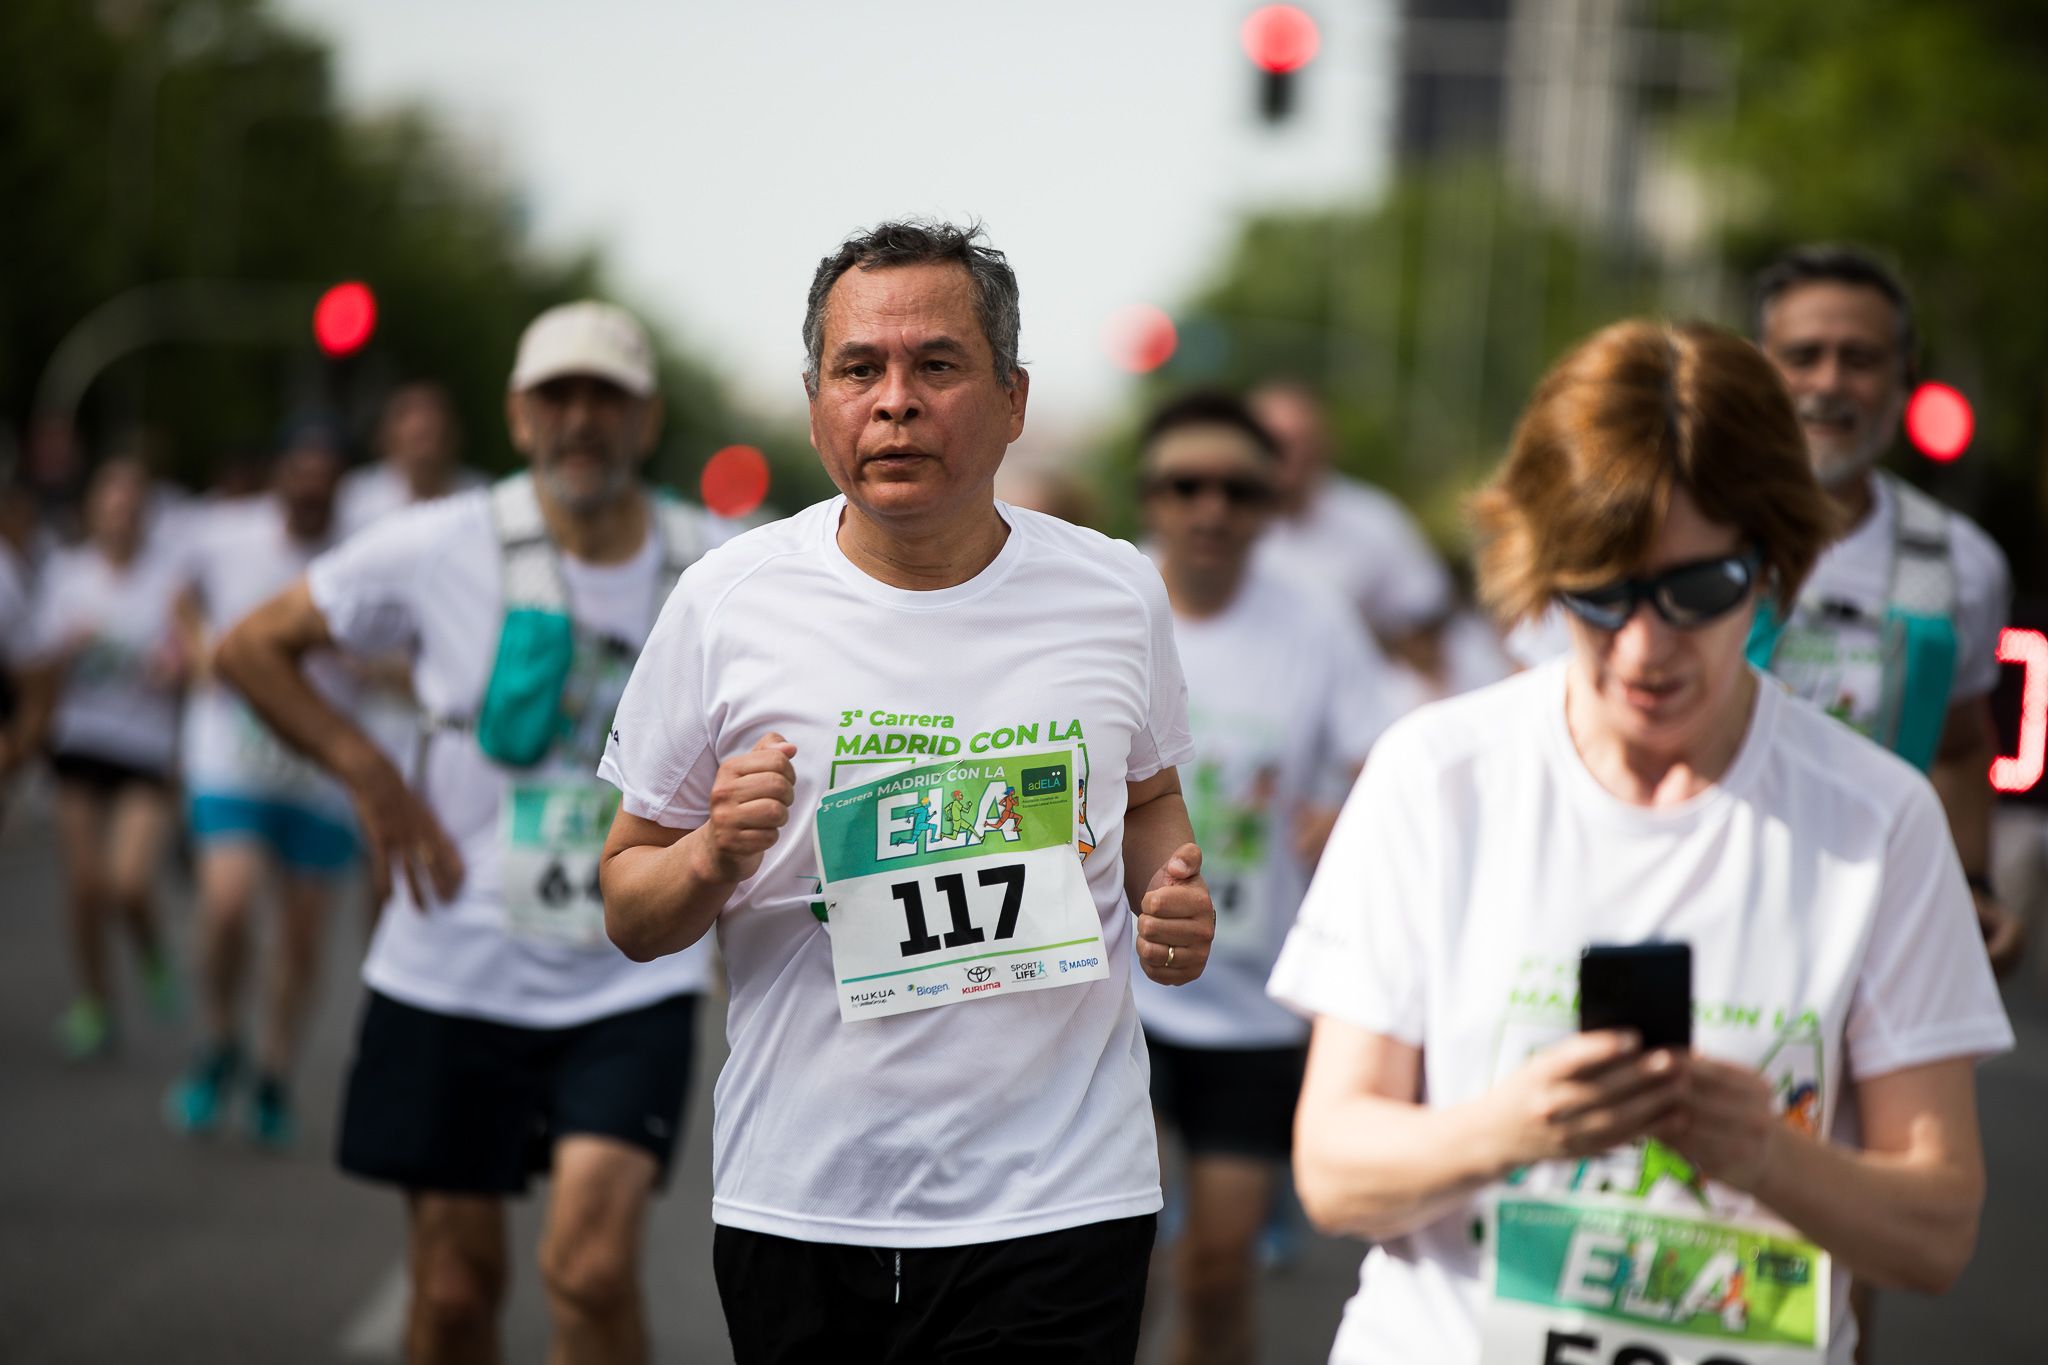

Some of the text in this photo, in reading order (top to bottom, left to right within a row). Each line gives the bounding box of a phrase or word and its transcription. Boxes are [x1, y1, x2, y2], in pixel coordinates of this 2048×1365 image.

[869, 710, 955, 729] Carrera
[834, 719, 1084, 757] MADRID CON LA
[835, 791, 873, 809] Carrera
[877, 772, 942, 797] MADRID
[946, 767, 980, 782] CON
[984, 766, 1006, 779] LA
[875, 780, 1021, 862] ELA
[891, 863, 1026, 958] 117
[1010, 961, 1038, 973] SPORT
[1069, 957, 1099, 970] MADRID
[1015, 970, 1037, 981] LIFE
[850, 988, 896, 1003] MUKUA
[916, 983, 949, 997] Biogen
